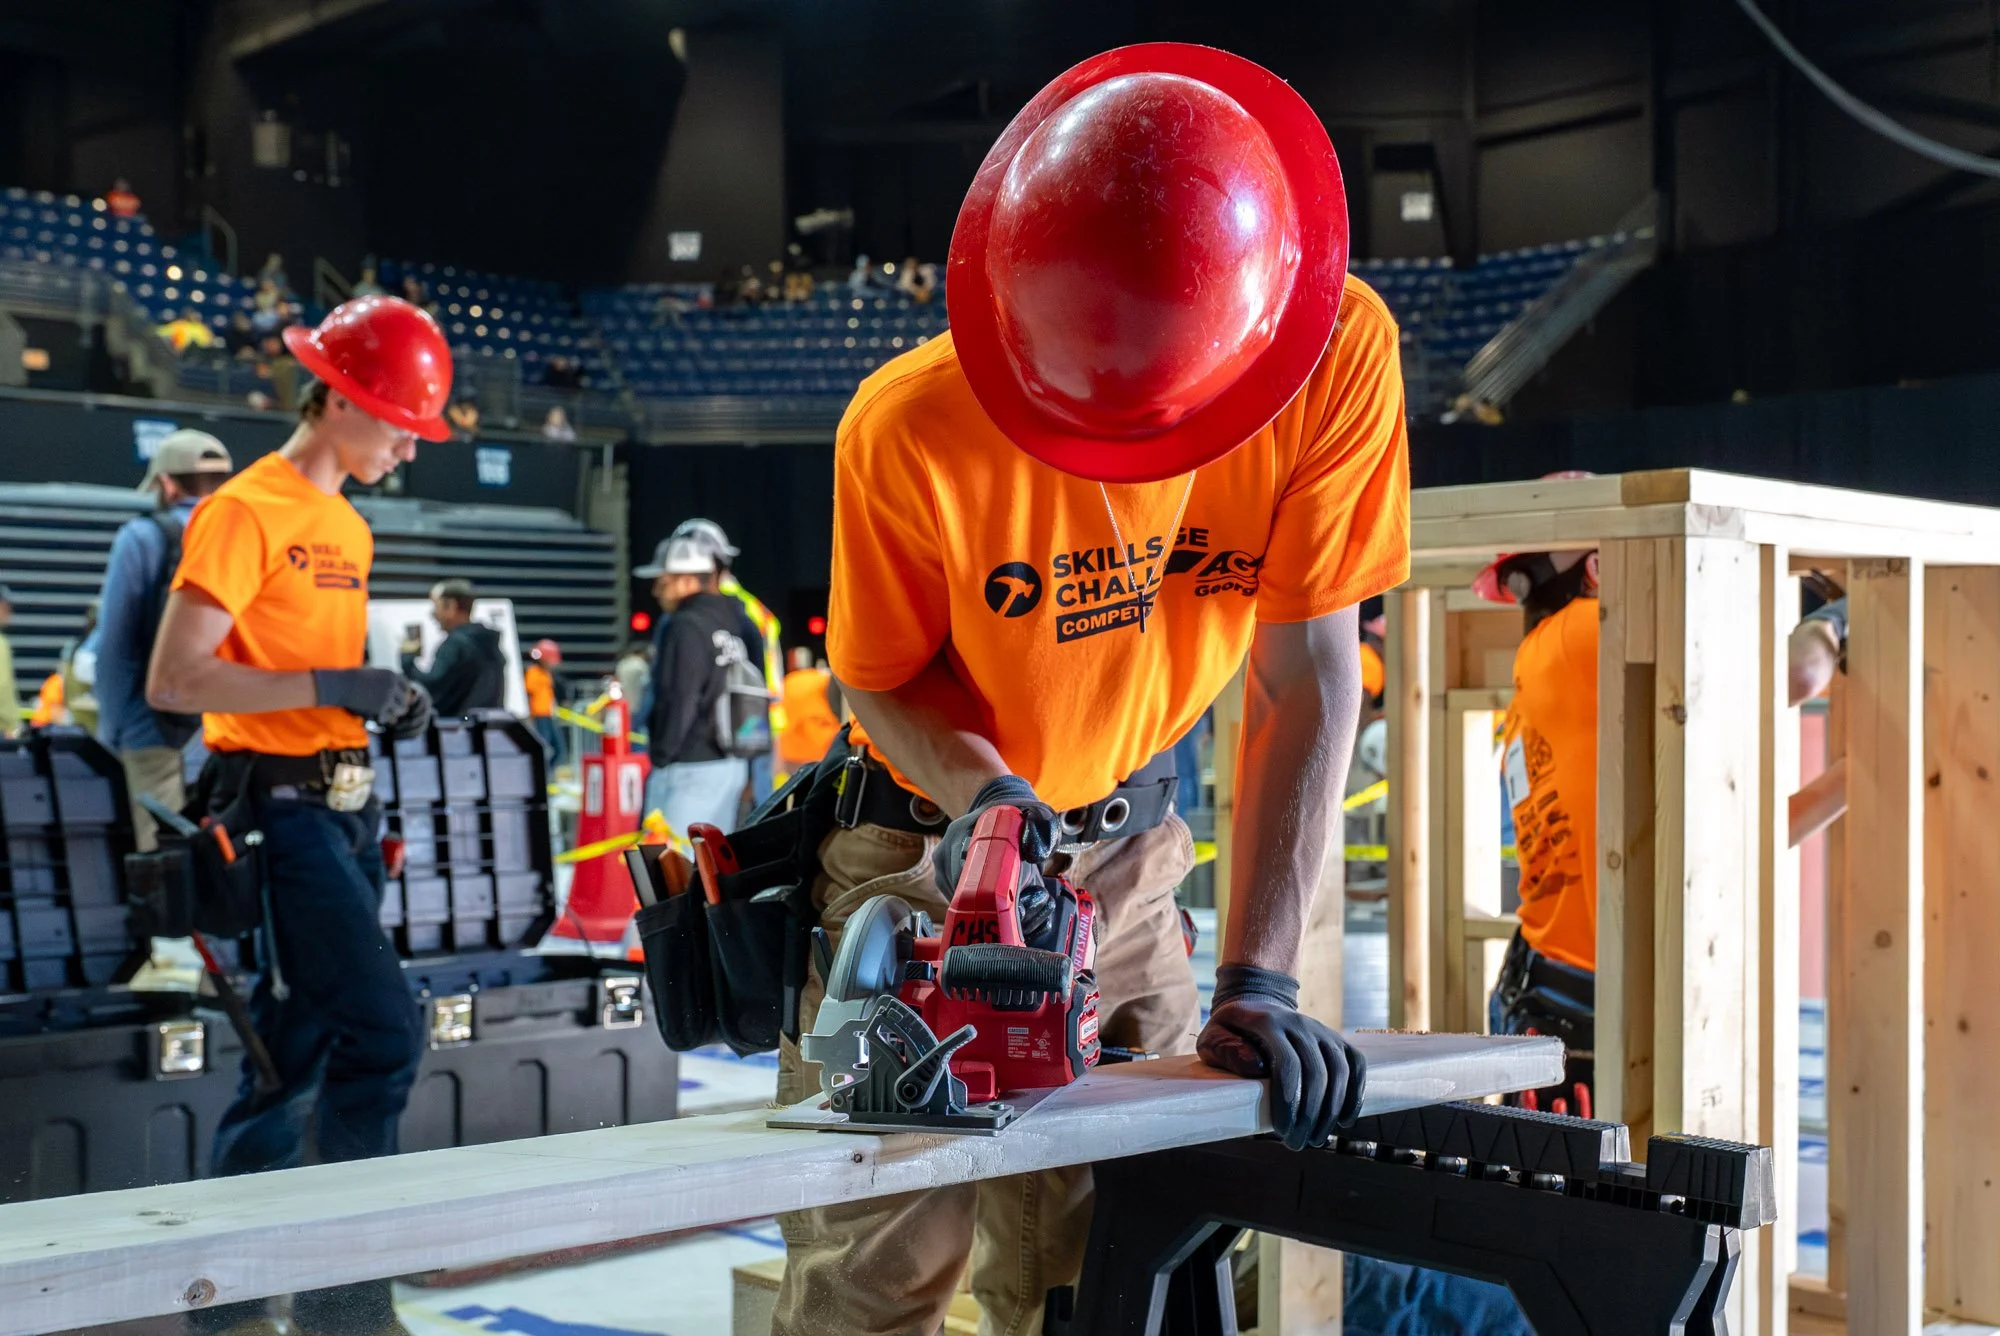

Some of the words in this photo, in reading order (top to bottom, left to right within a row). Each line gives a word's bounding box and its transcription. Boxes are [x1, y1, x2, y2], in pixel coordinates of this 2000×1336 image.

[1053, 536, 1163, 578] SKILLS
[1056, 566, 1161, 607] CHALL
[1195, 582, 1258, 597] Georg
[1062, 605, 1141, 636] COMPET
